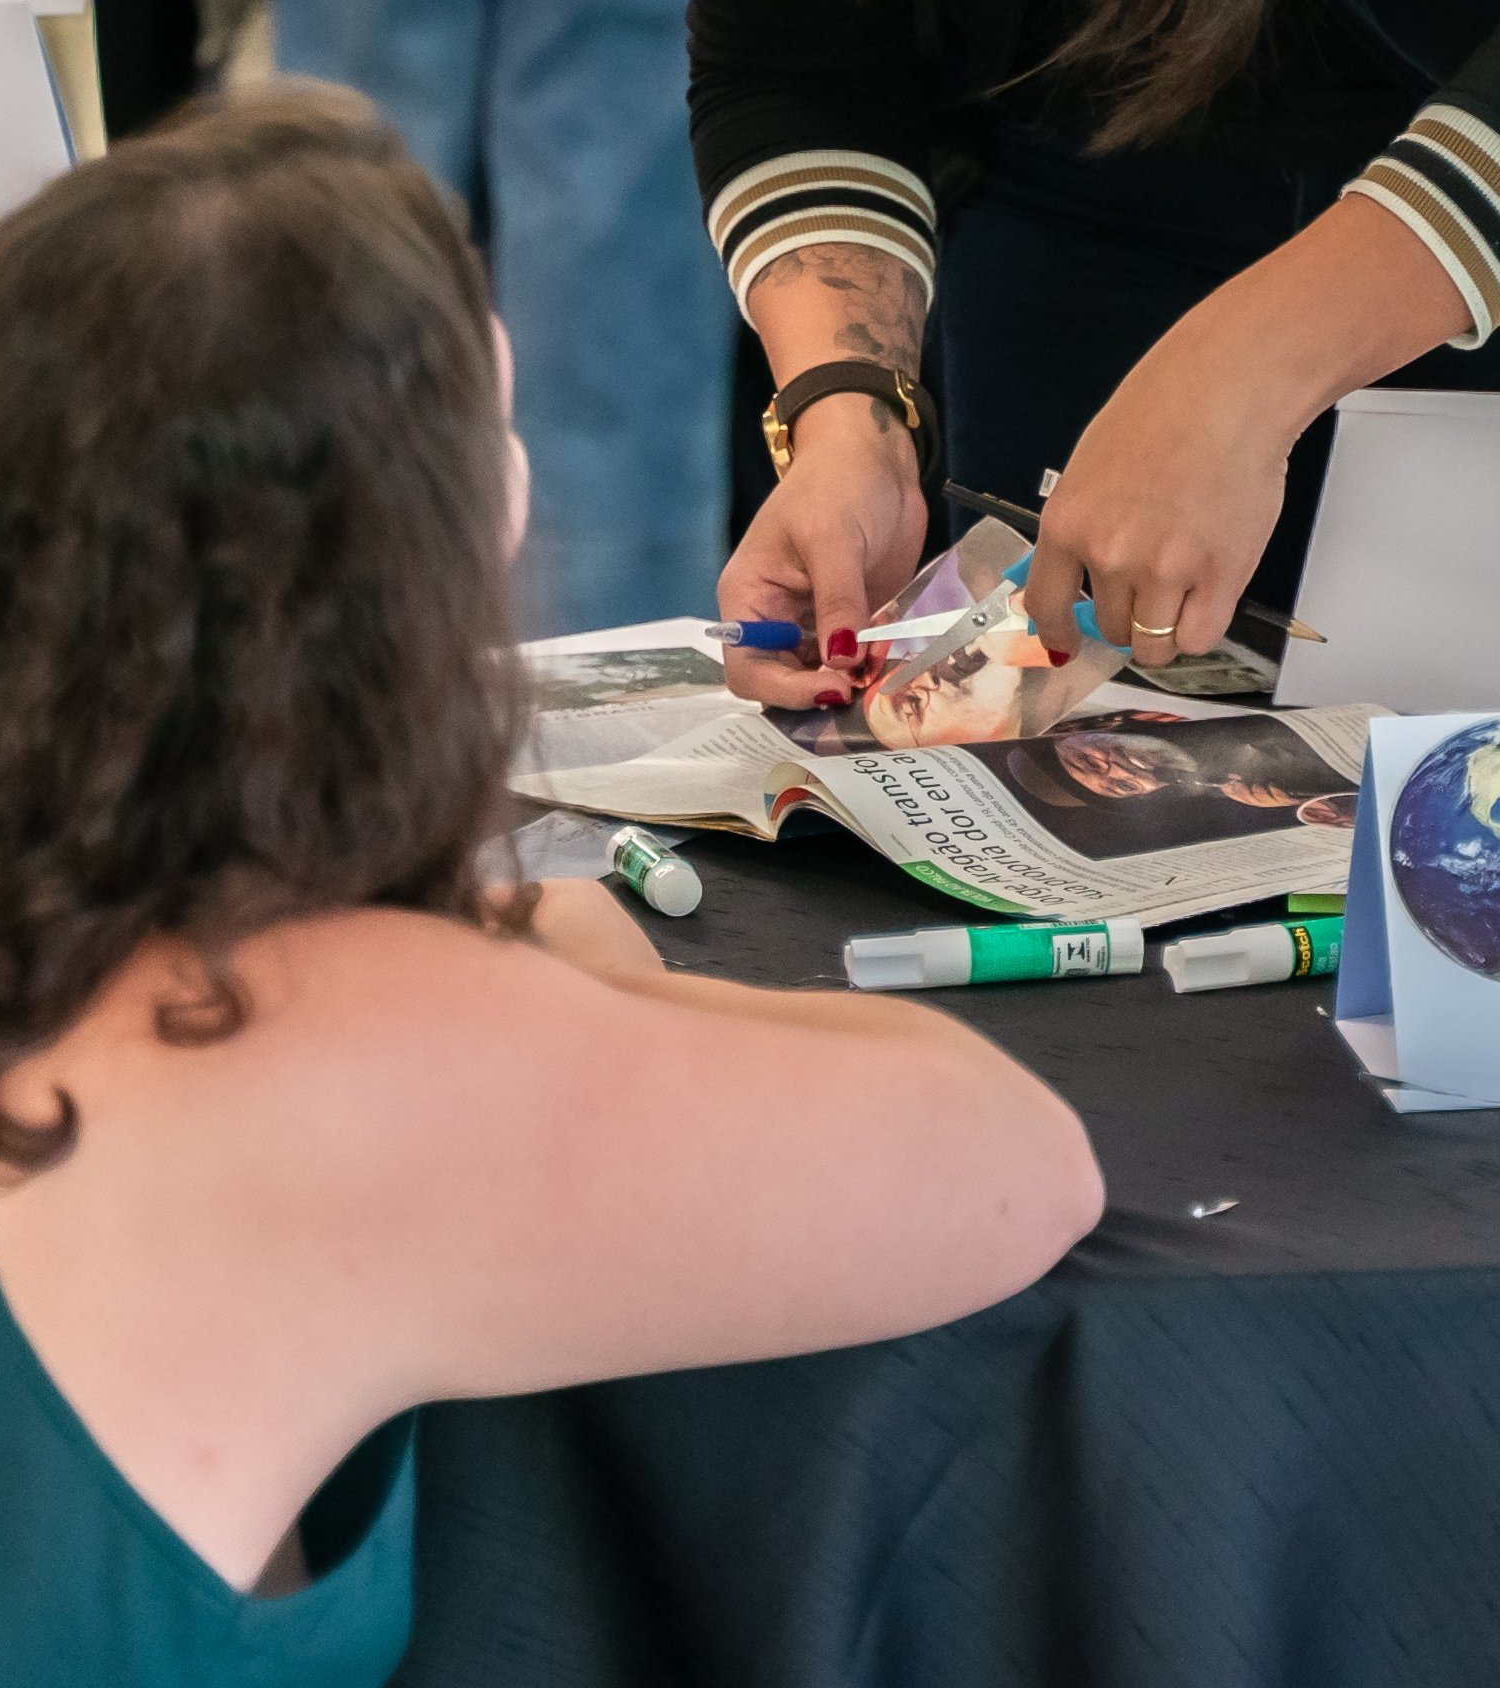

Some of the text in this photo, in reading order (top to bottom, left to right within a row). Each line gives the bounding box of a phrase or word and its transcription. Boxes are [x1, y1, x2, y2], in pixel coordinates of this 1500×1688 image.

[908, 769, 950, 801] em
[941, 807, 989, 841] dor
[925, 831, 1013, 883] Aragão
[981, 845, 1079, 887] própria
[1004, 884, 1078, 906] Jorge
[1063, 885, 1113, 899] sua
[1293, 927, 1311, 977] Scotch
